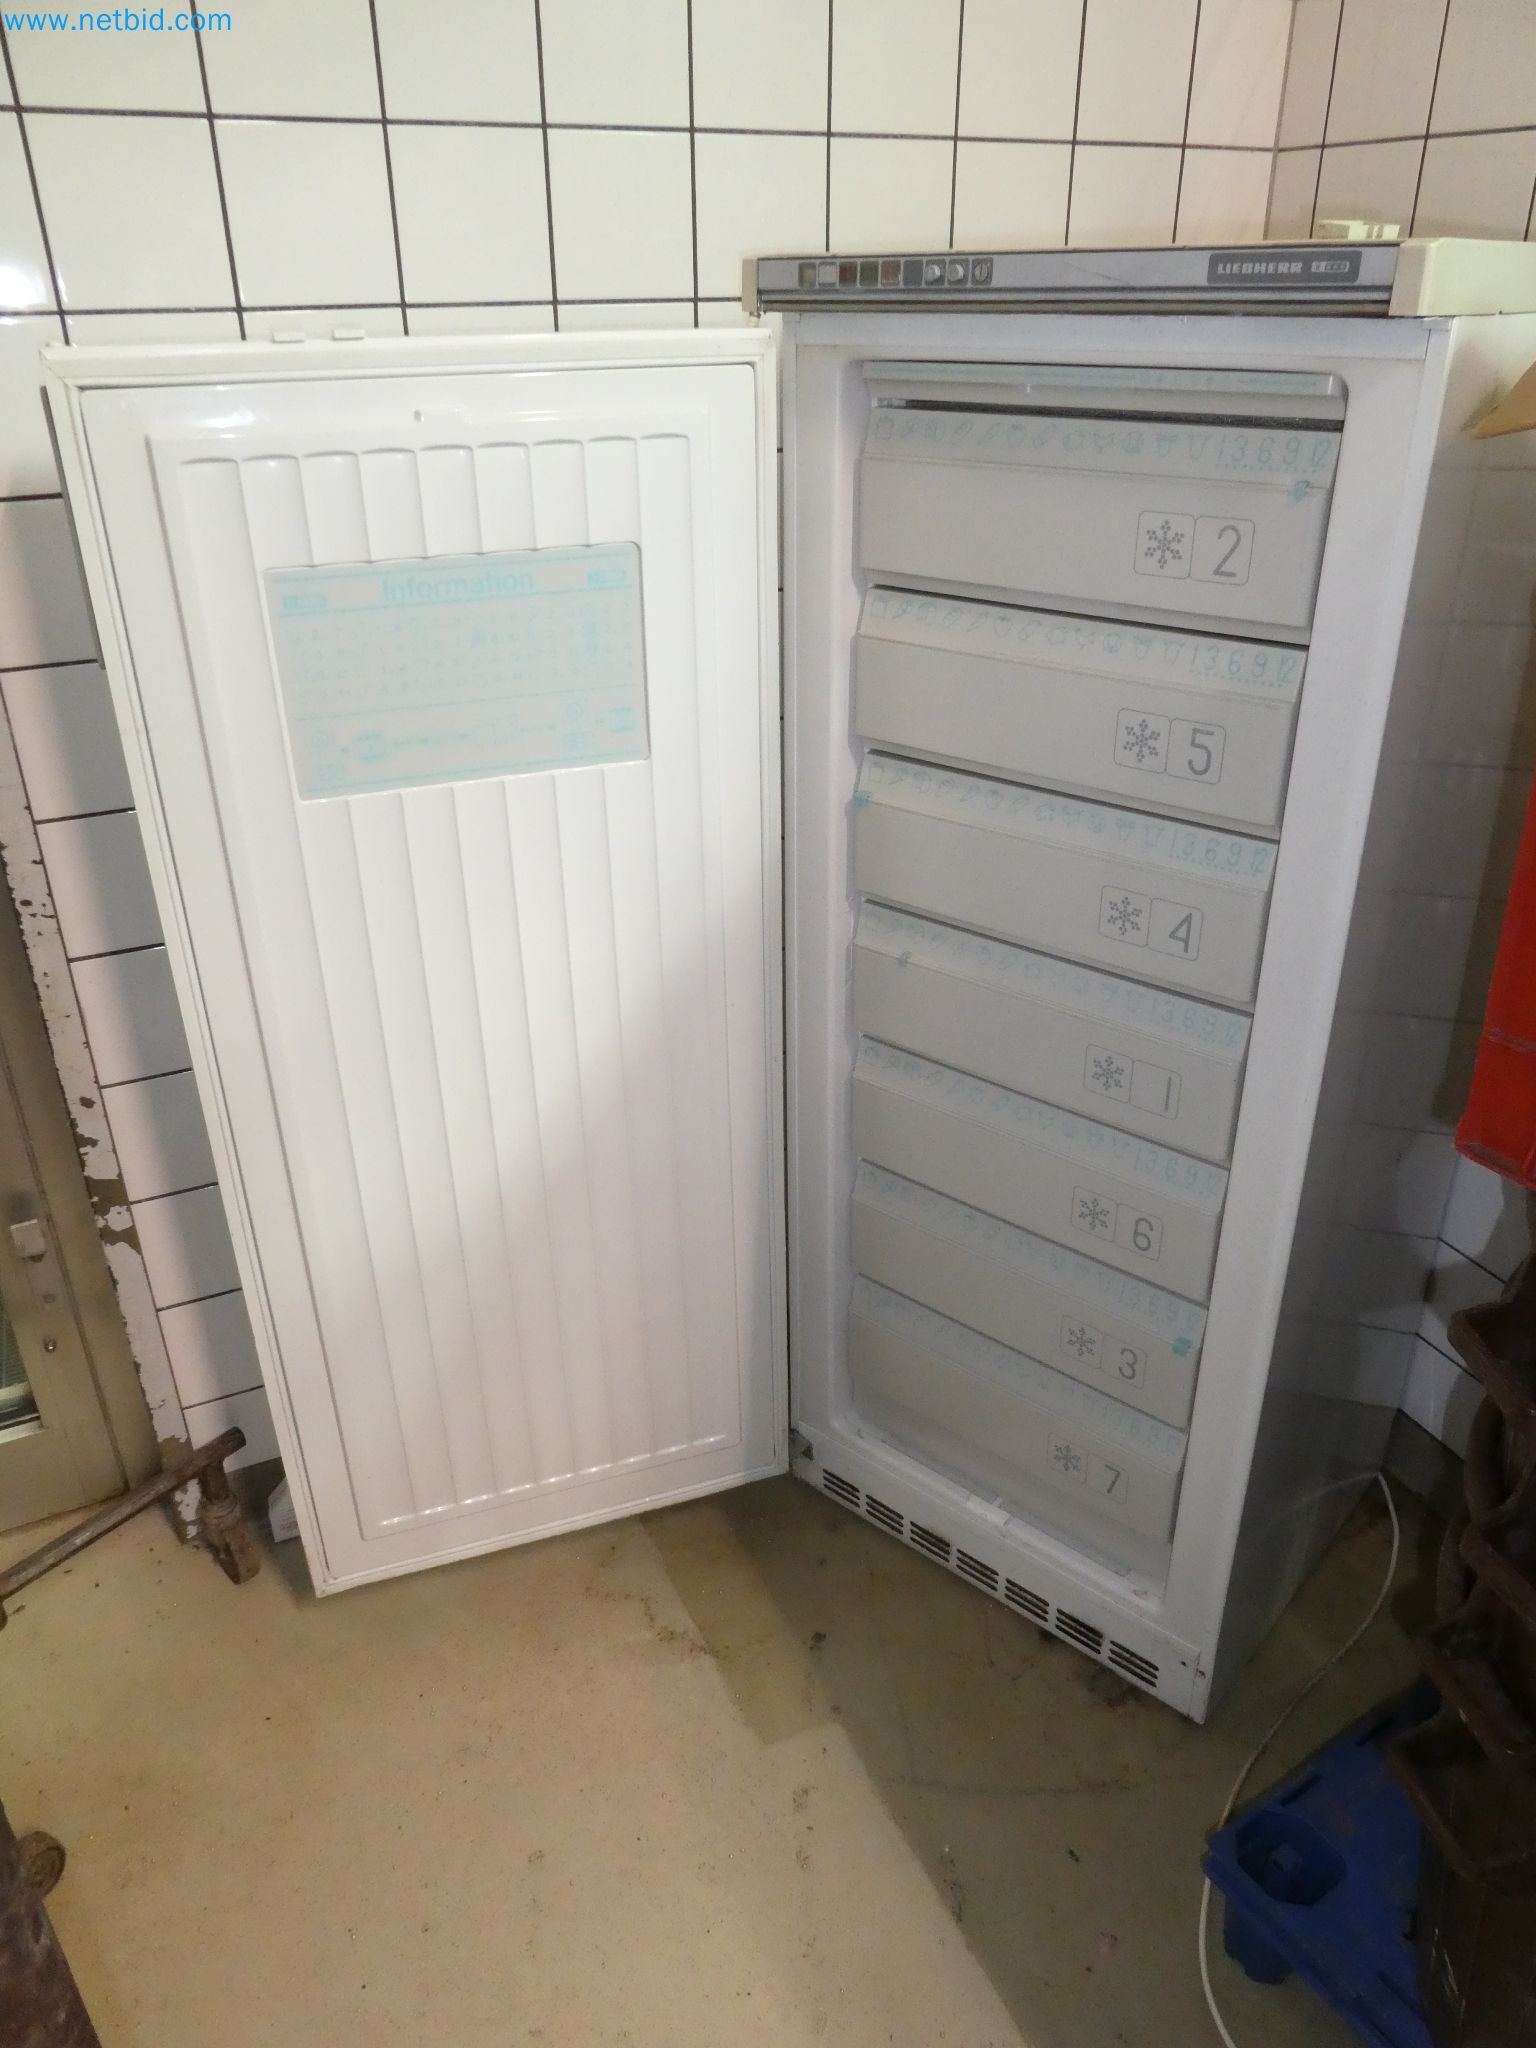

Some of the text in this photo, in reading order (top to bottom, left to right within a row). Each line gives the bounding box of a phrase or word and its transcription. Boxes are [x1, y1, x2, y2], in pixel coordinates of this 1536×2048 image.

[1217, 262, 1303, 274] LIEBHERR
[1213, 525, 1242, 577] 2
[381, 570, 536, 601] Information
[1187, 728, 1215, 776] 5
[1168, 912, 1193, 954] 4
[1133, 1217, 1154, 1252] 6
[1118, 1348, 1138, 1380] 3
[1105, 1464, 1121, 1494] 7
